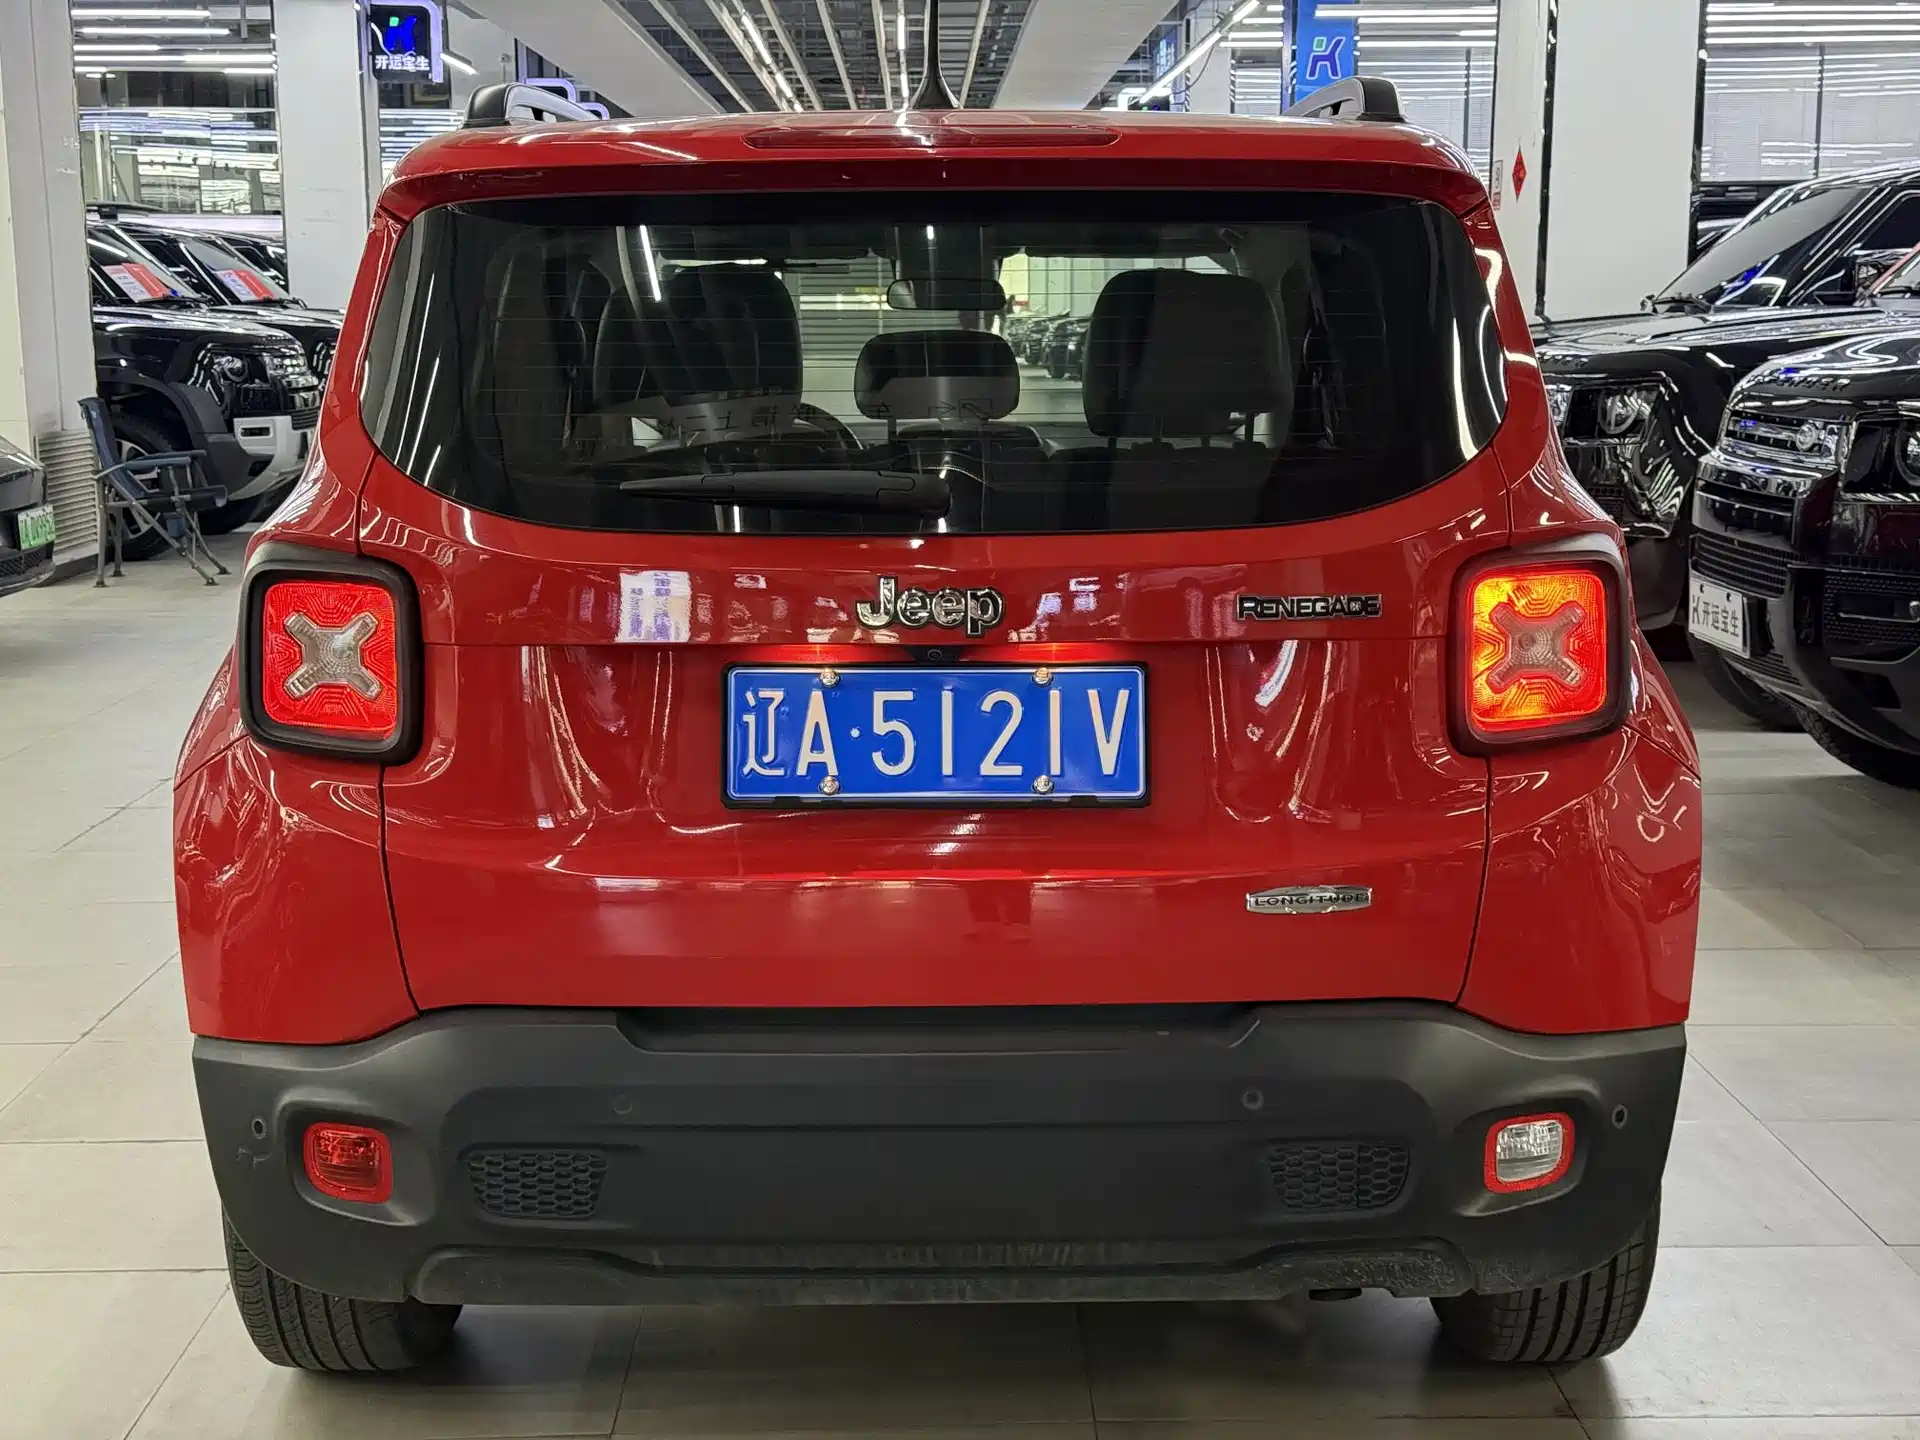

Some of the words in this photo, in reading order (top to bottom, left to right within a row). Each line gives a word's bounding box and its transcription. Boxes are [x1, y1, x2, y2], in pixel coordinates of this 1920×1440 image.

[856, 575, 1005, 637] Jeep
[1237, 594, 1382, 620] RENEGADE
[1254, 892, 1369, 906] LONGITUDE
